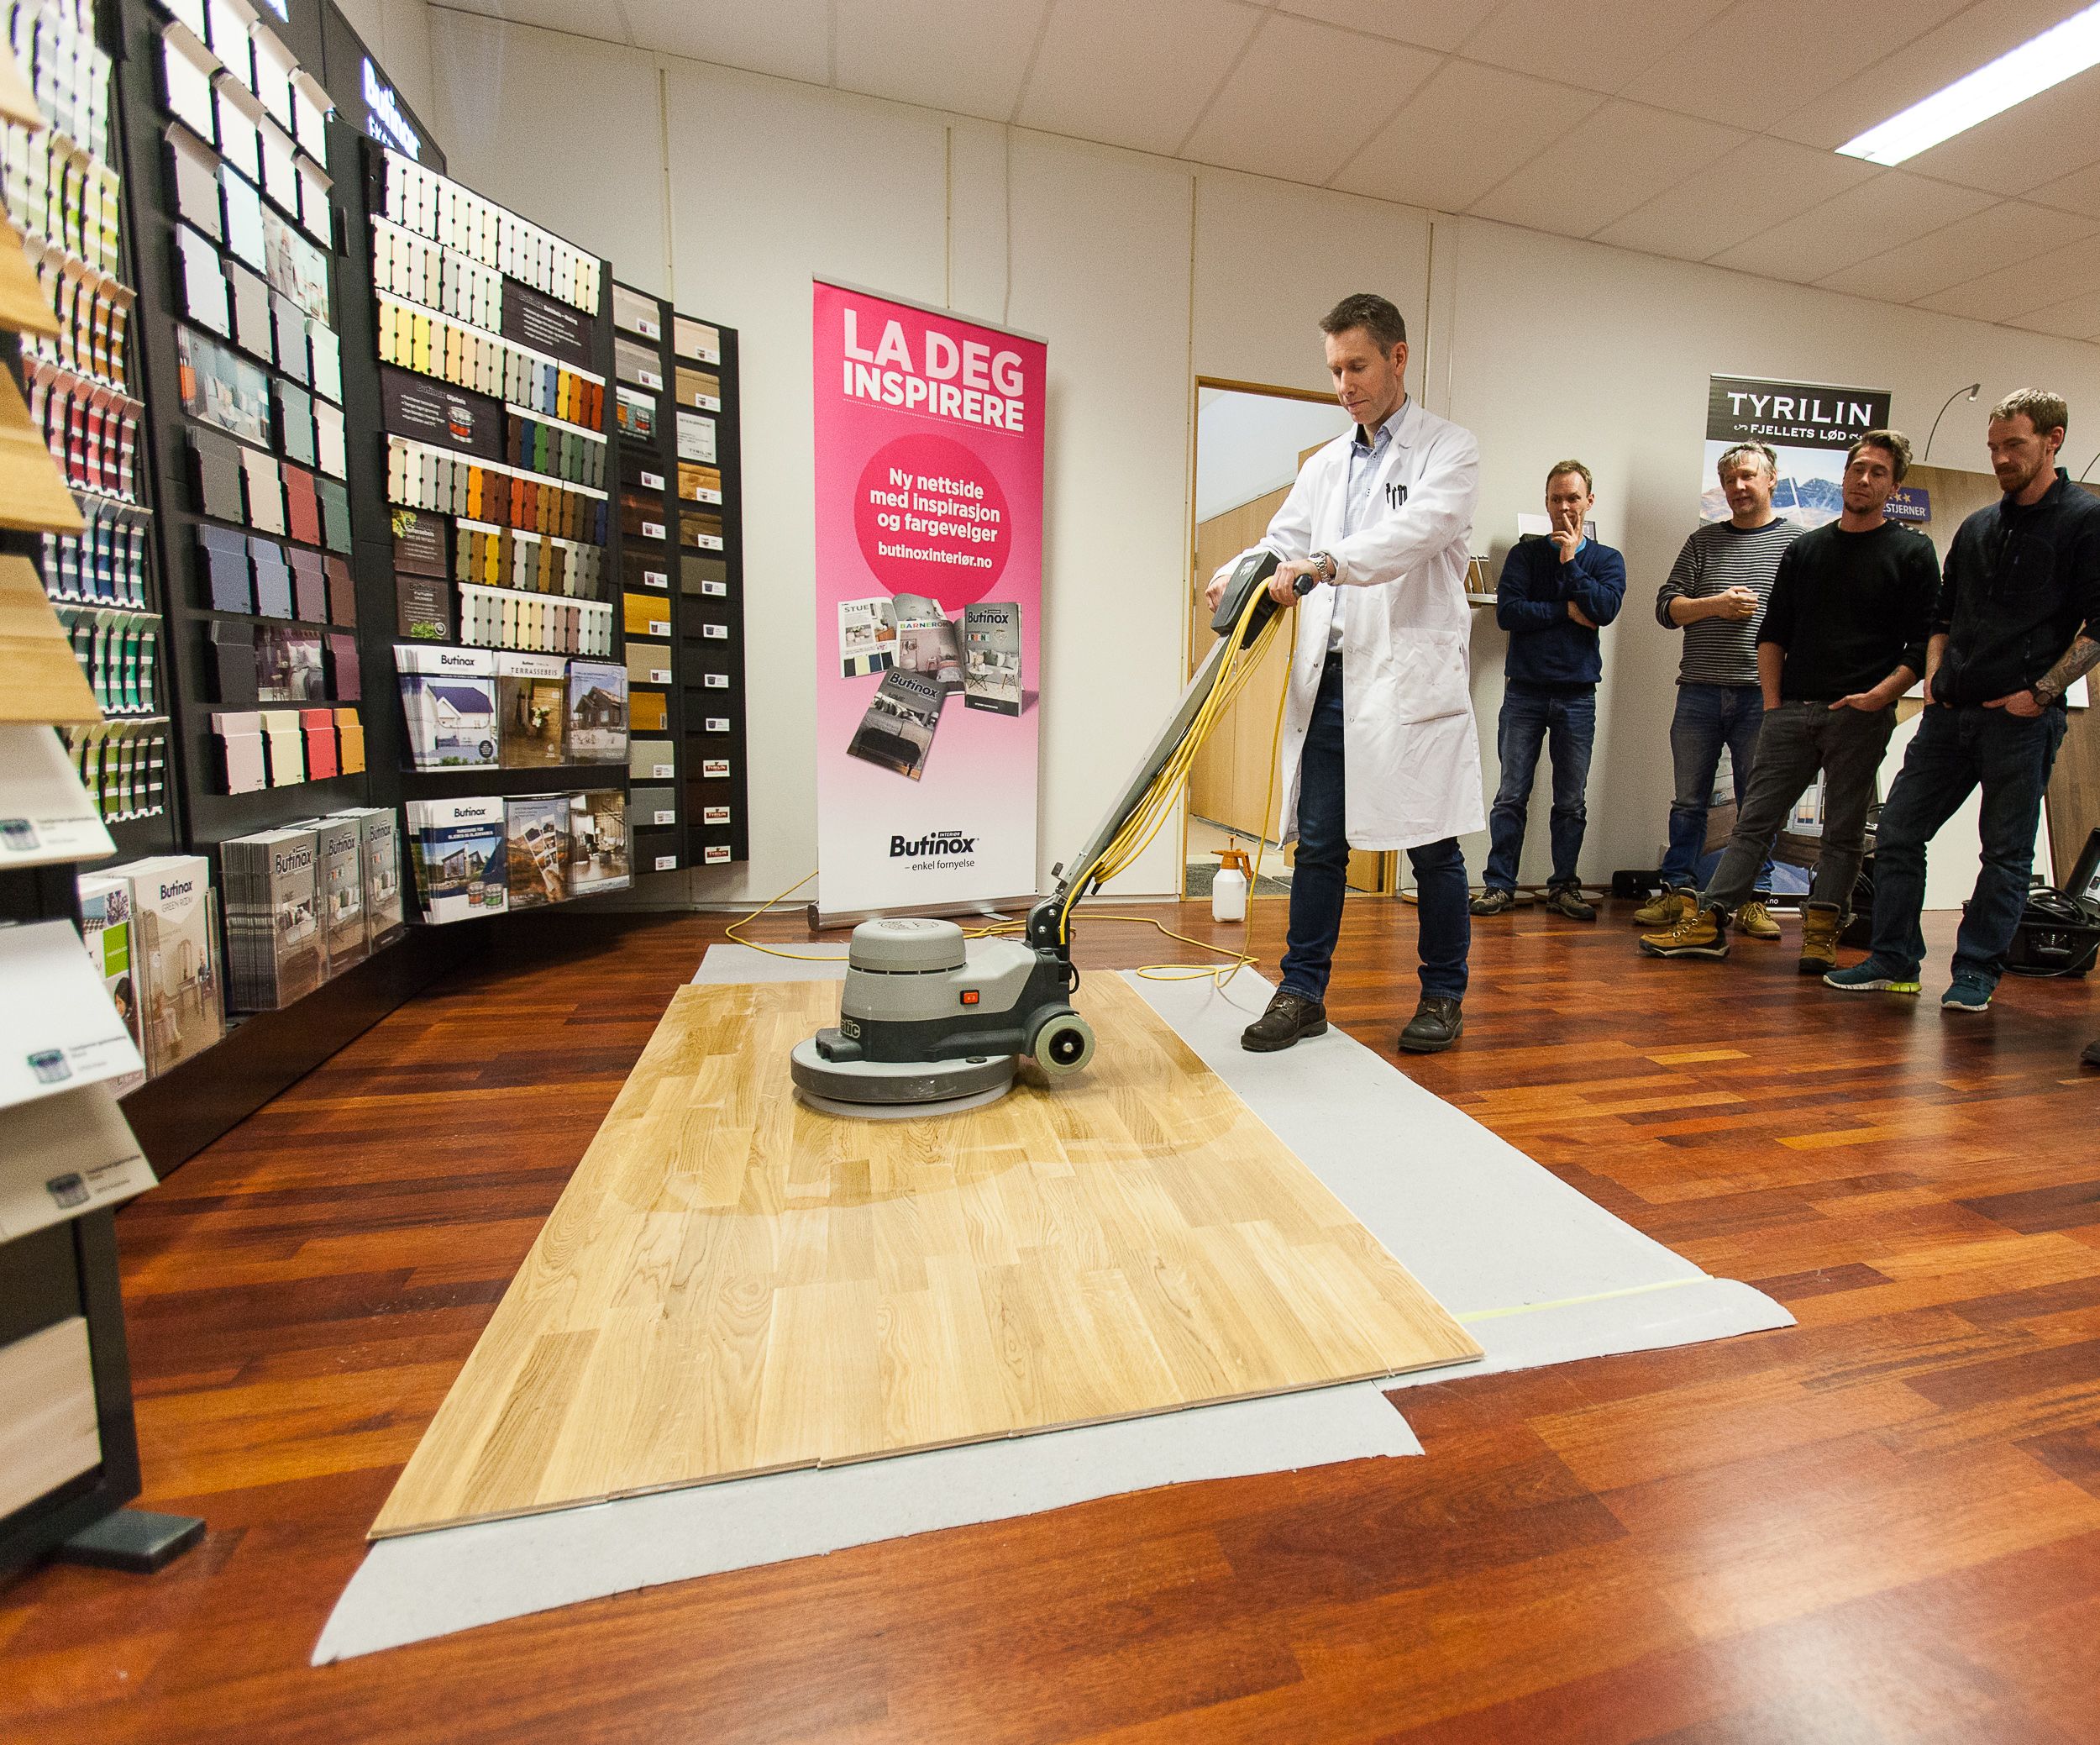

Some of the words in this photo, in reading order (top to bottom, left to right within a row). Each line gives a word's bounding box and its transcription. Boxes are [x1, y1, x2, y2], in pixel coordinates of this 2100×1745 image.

[843, 307, 914, 373] LA
[925, 329, 1024, 397] DEG
[843, 360, 1025, 433] INSPIRERE
[1726, 391, 1873, 427] TYRILIN
[1750, 423, 1815, 439] FJELLETS
[1819, 428, 1847, 442] LØD
[889, 467, 913, 491] Ny
[916, 475, 984, 500] nettside
[869, 489, 909, 509] med
[912, 491, 1000, 523] inspirasjon
[876, 513, 900, 533] og
[904, 512, 998, 543] fargevelger
[878, 540, 993, 569] butinoxinteriør.no
[843, 604, 869, 613] STUE
[968, 609, 1010, 624] Butinox
[441, 654, 475, 666] Butinox
[889, 672, 939, 698] Butinox
[454, 807, 487, 817] Butinox
[890, 832, 977, 858] Butinox
[275, 847, 314, 875] Butinox
[911, 860, 935, 871] enkel
[936, 859, 975, 871] fornyelse
[160, 880, 194, 901] Butinox
